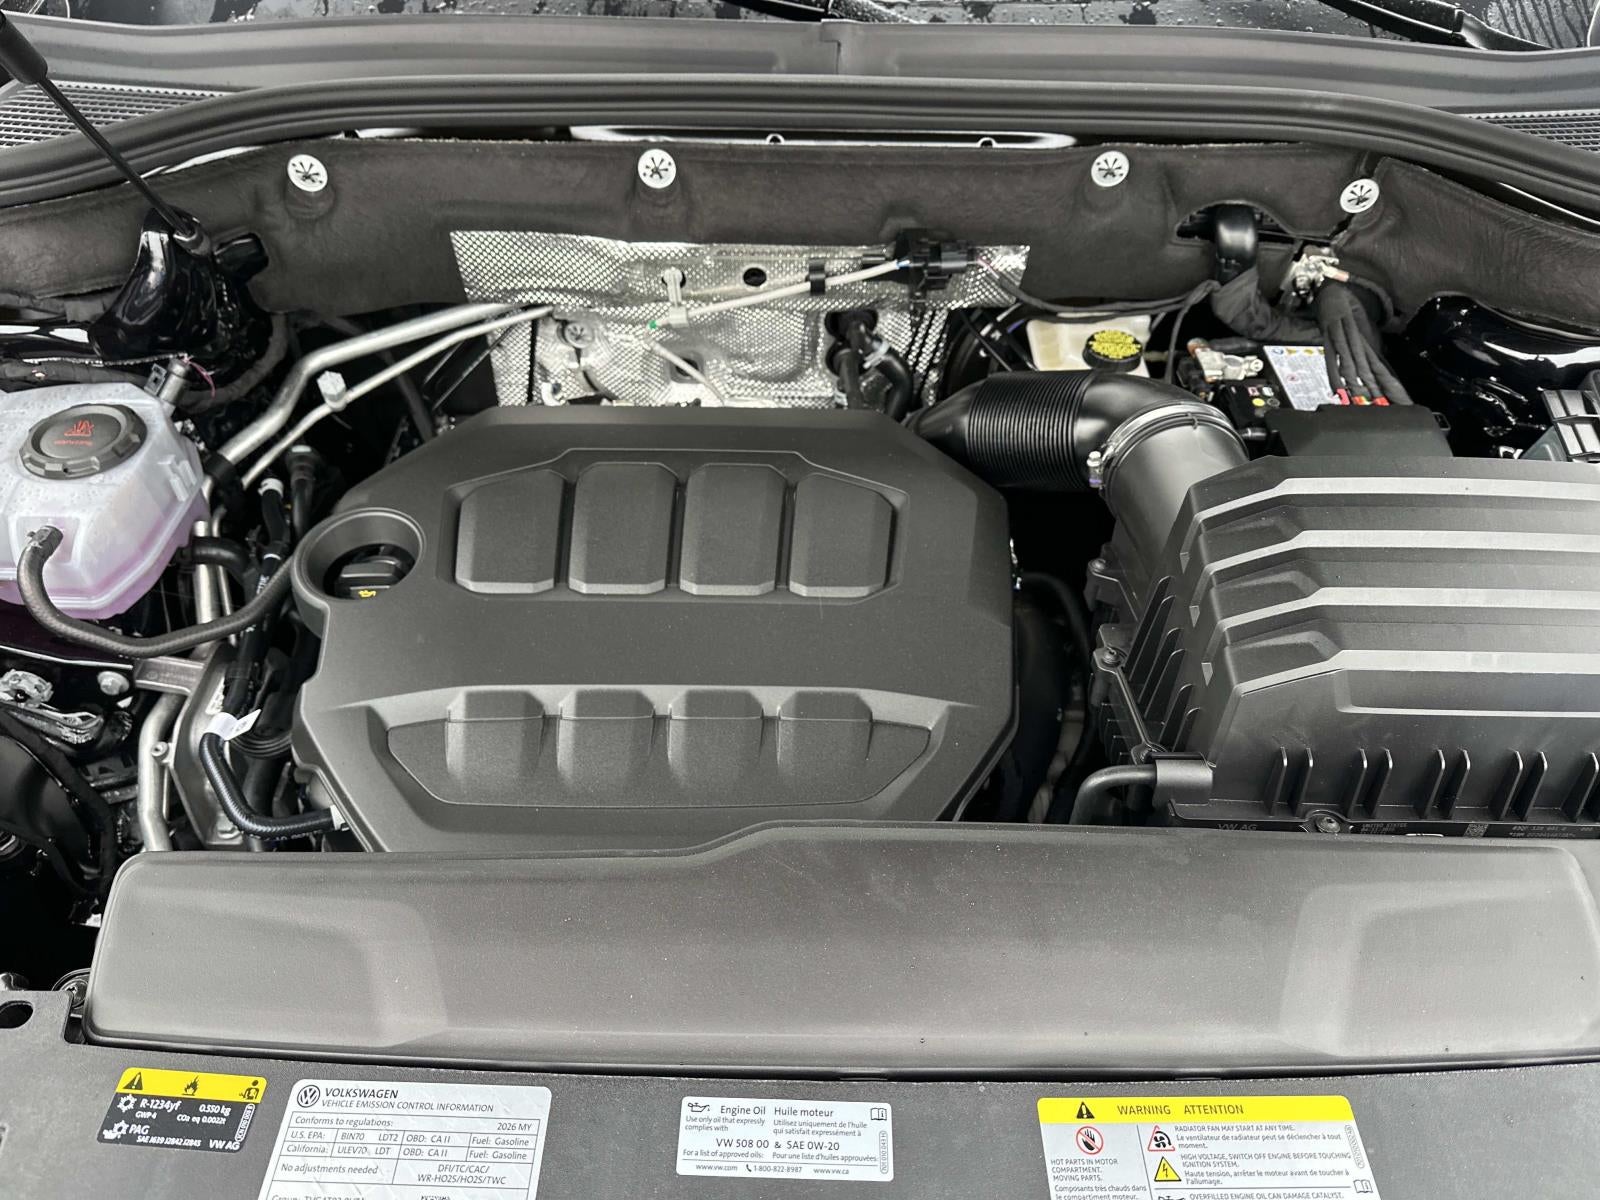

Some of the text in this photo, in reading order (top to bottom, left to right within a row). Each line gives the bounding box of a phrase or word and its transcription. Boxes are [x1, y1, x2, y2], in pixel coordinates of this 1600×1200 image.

[325, 1088, 398, 1099] VOLKSWAGEN
[140, 1099, 231, 1116] R-1234yf 0.550 kg
[322, 1100, 494, 1112] VEHICLE EMISSION CONTROL INFORMATION
[720, 1105, 766, 1116] Engine Oil
[1117, 1105, 1244, 1115] WARNING ATTENTION
[774, 1107, 834, 1117] Huile moteur
[295, 1116, 394, 1128] Conforms to regulations:
[699, 1116, 713, 1125] only
[735, 1118, 765, 1126] expressly
[774, 1119, 797, 1127] Utilisez
[129, 1124, 150, 1134] PAG
[518, 1123, 532, 1131] MY
[685, 1125, 712, 1133] complies
[341, 1132, 398, 1142] BIN70 LDT2
[811, 1129, 854, 1137] expressément
[431, 1135, 442, 1143] CA
[472, 1137, 529, 1147] Fuel: Gasoline
[209, 1139, 240, 1150] VW AG
[286, 1145, 328, 1153] California:
[716, 1138, 840, 1151] VW 508 00 & SAE 0W-20
[337, 1146, 391, 1155] ULEV70 LDT
[403, 1148, 424, 1156] OBD:
[469, 1150, 527, 1160] Fuel: Gasoline
[719, 1151, 749, 1159] approved
[281, 1164, 378, 1174] No adjustments needed
[813, 1167, 849, 1175] www.vw.ca
